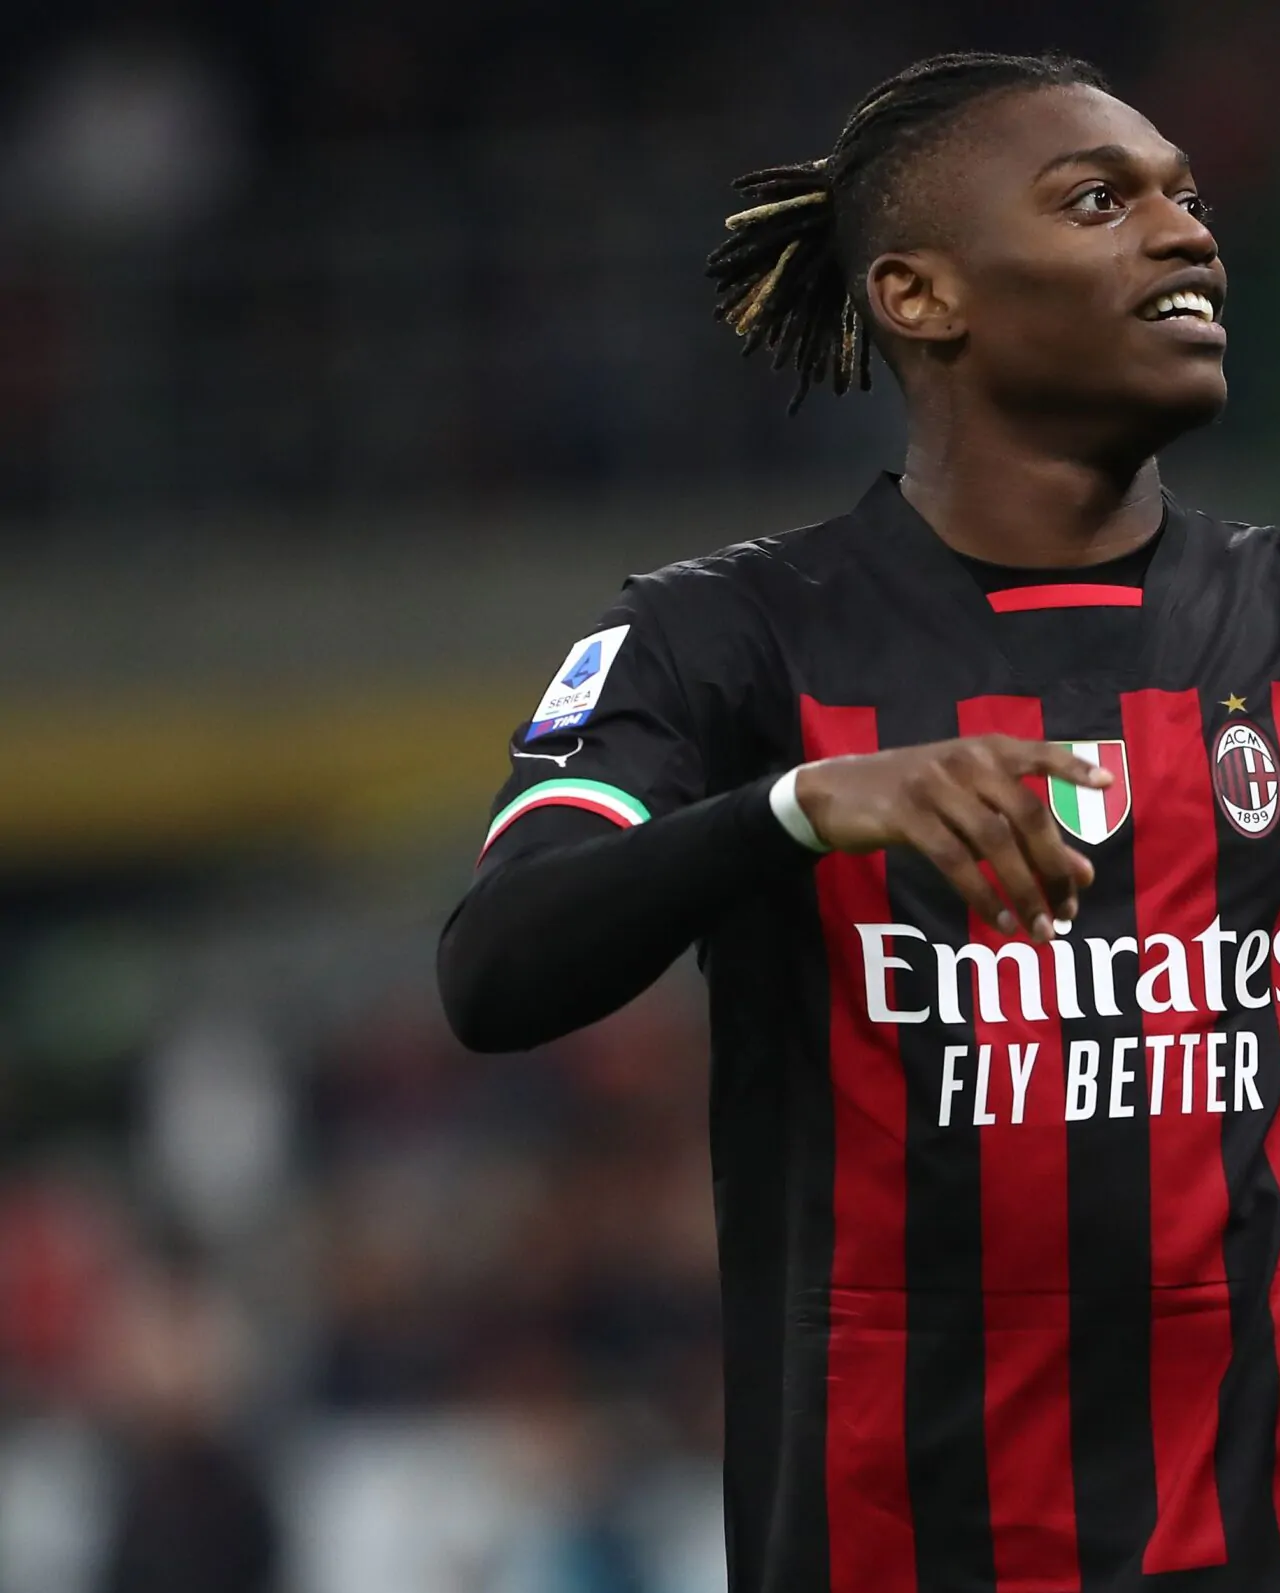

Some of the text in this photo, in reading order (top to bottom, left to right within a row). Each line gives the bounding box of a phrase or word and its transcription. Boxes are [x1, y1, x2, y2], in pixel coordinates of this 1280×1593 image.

[548, 690, 591, 708] SERIE A
[552, 713, 583, 729] TIM
[1224, 729, 1261, 750] ACM
[1237, 810, 1269, 823] 1899
[938, 1031, 1264, 1126] FLY BETTER
